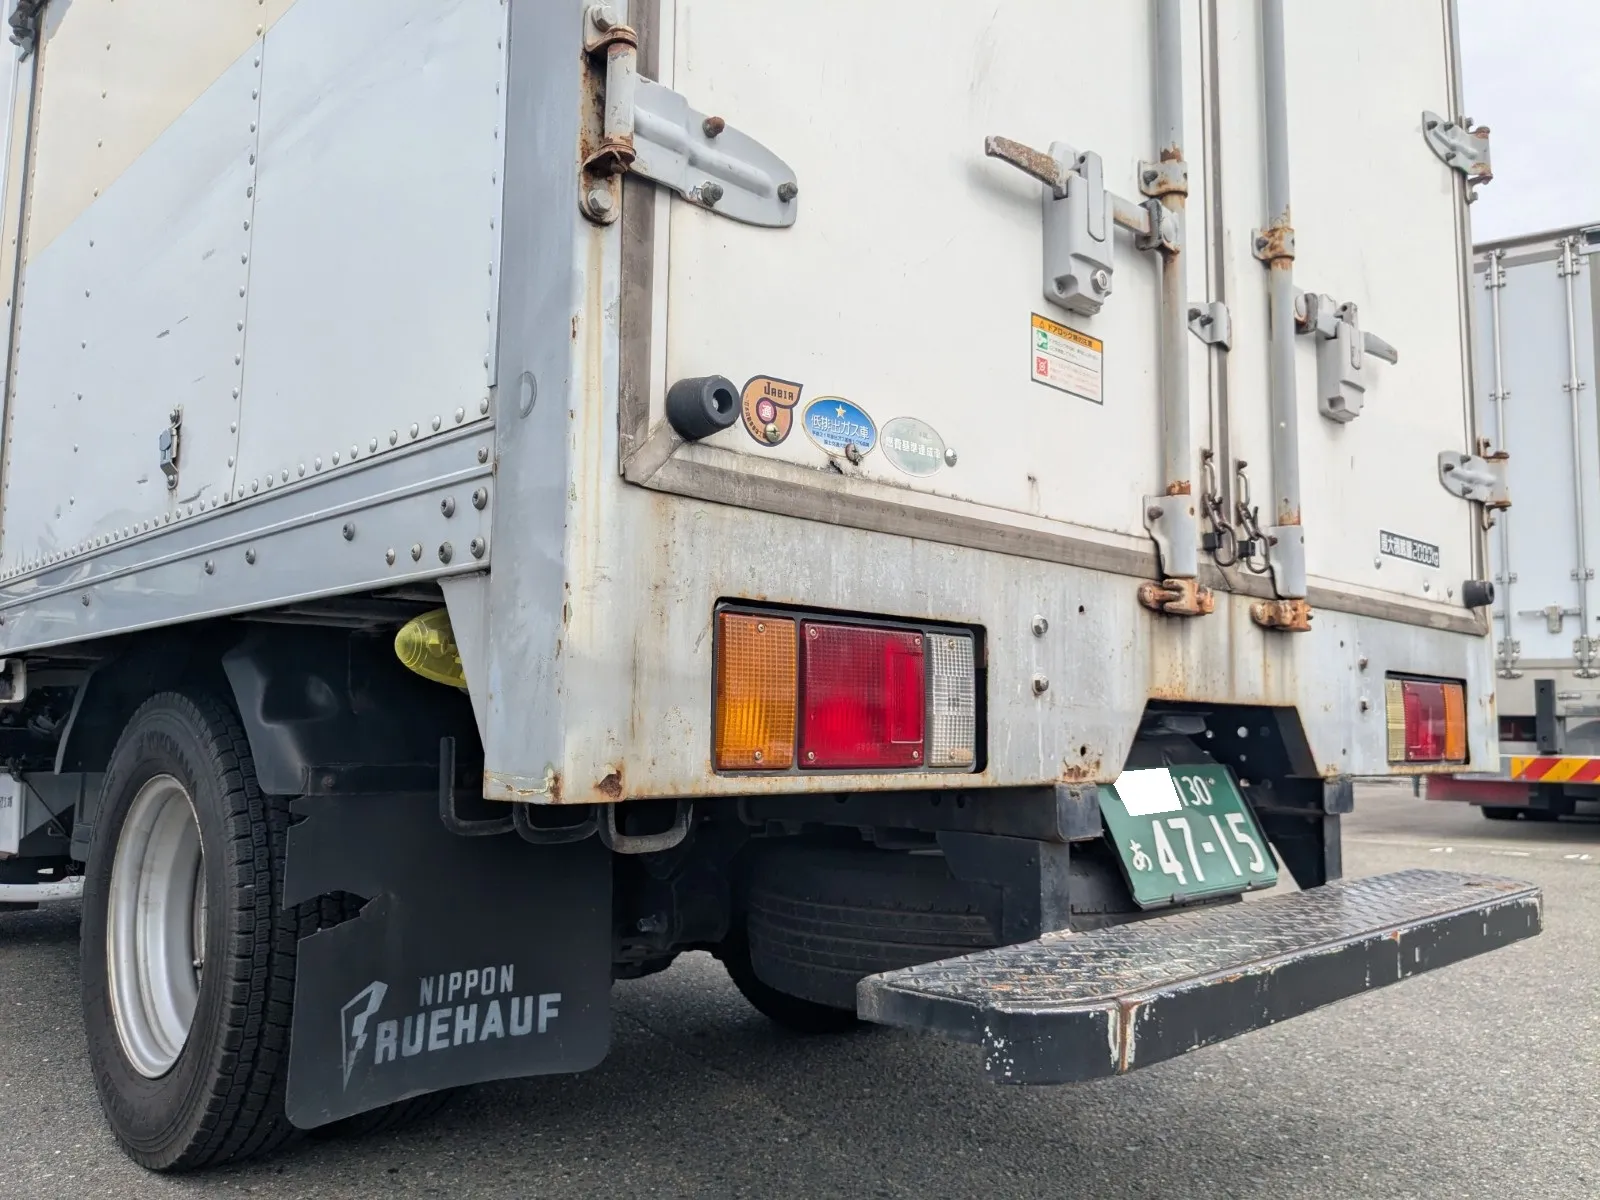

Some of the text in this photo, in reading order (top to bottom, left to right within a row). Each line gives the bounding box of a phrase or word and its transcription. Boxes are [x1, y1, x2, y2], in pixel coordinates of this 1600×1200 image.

[811, 413, 870, 440] 低排出ガス車
[1172, 775, 1213, 807] 130
[1129, 812, 1265, 885] あ 47-15
[419, 964, 514, 1007] NIPPON
